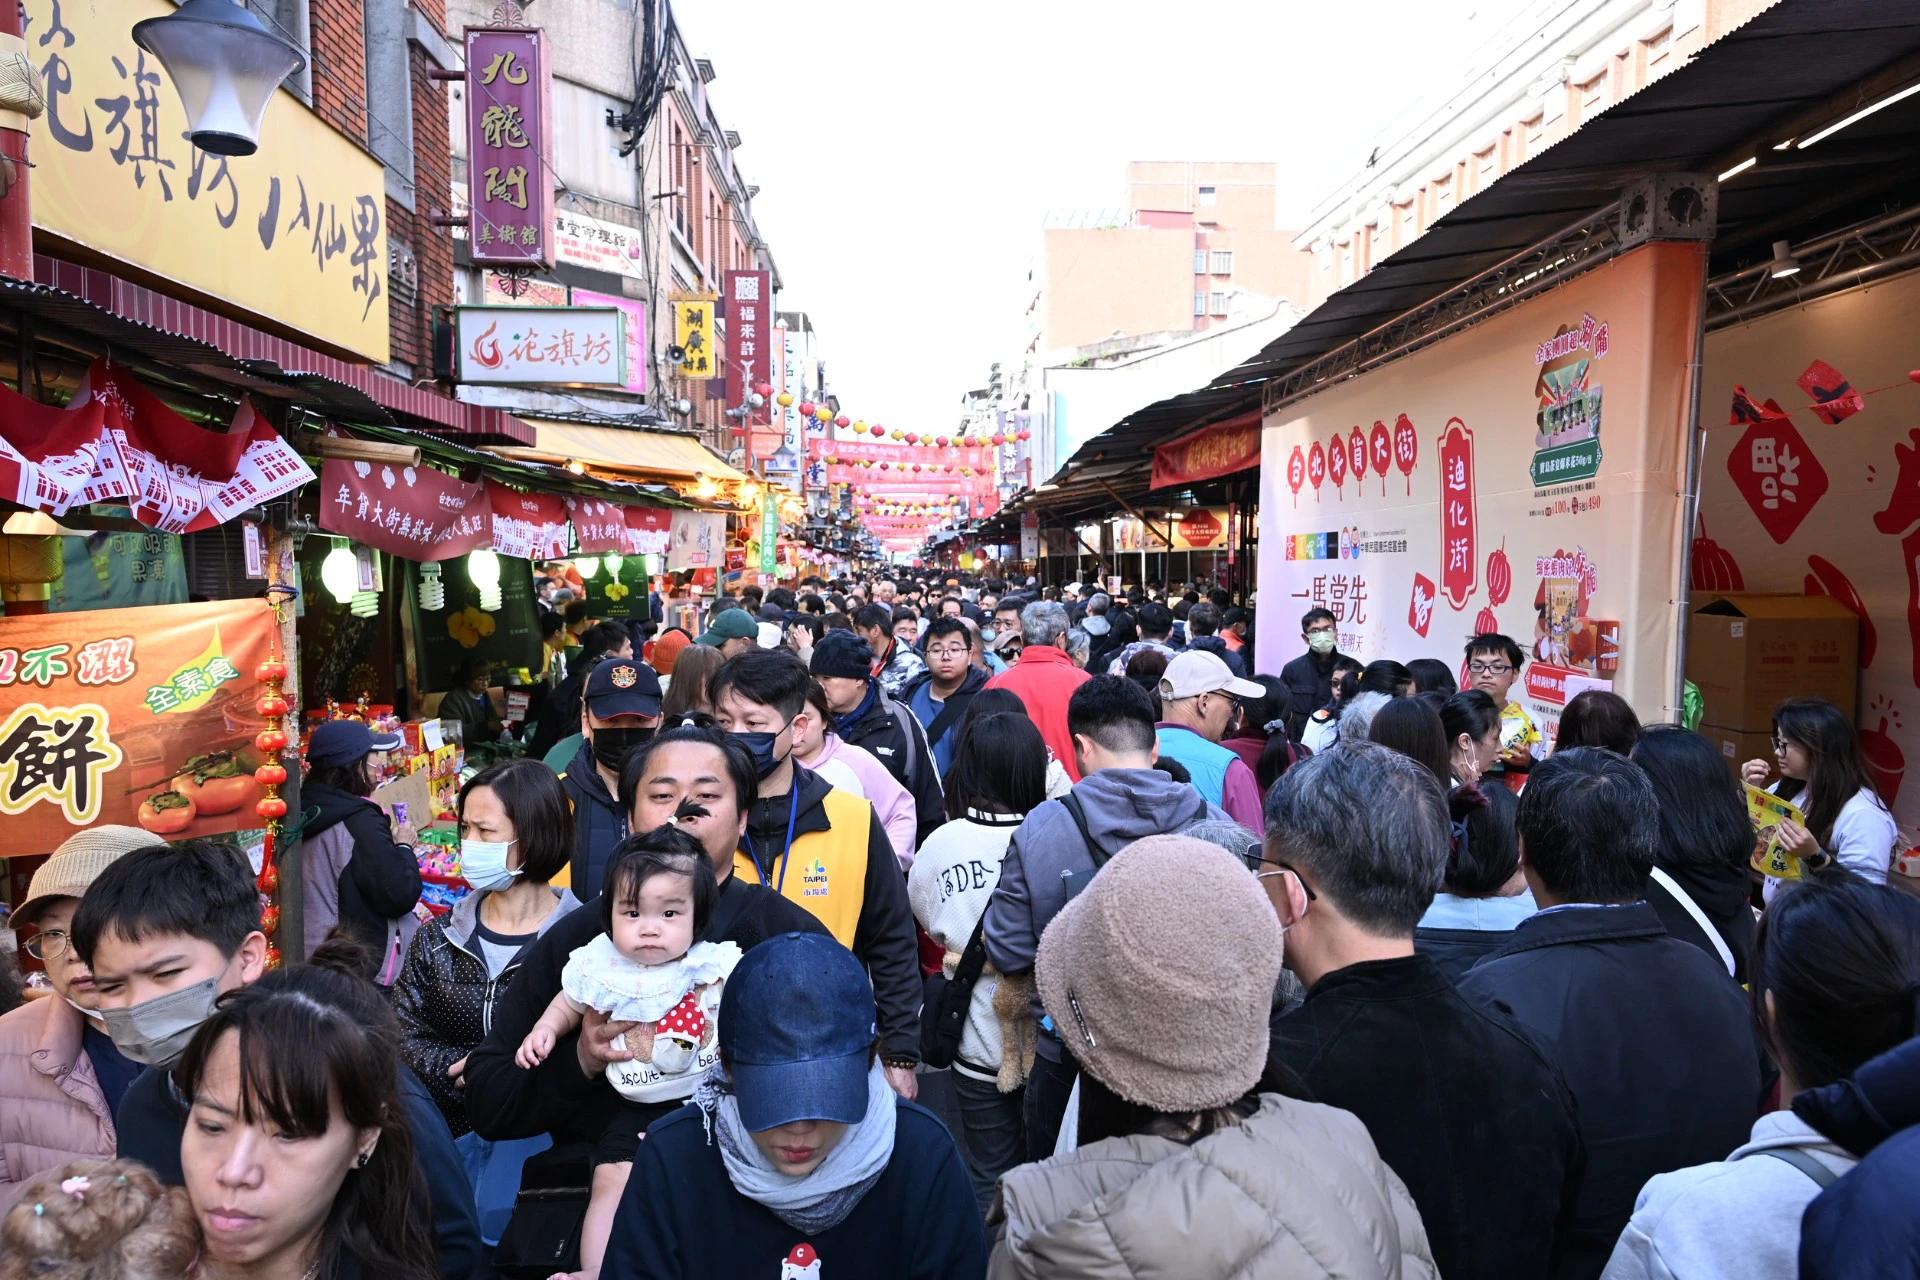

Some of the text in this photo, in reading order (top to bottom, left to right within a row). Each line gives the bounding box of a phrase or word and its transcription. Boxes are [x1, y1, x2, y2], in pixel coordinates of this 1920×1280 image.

[508, 326, 611, 367] 花旗坊
[805, 413, 825, 483] 萬堂
[1289, 427, 1416, 485] 台北年貨大街
[1447, 457, 1470, 574] 迪化街
[113, 533, 176, 556] 可以吸的
[131, 559, 165, 583] 果凍
[1291, 573, 1368, 625] 一馬當先
[1335, 632, 1364, 654] 等明天
[145, 656, 239, 714] 全素食
[0, 713, 106, 815] 餅
